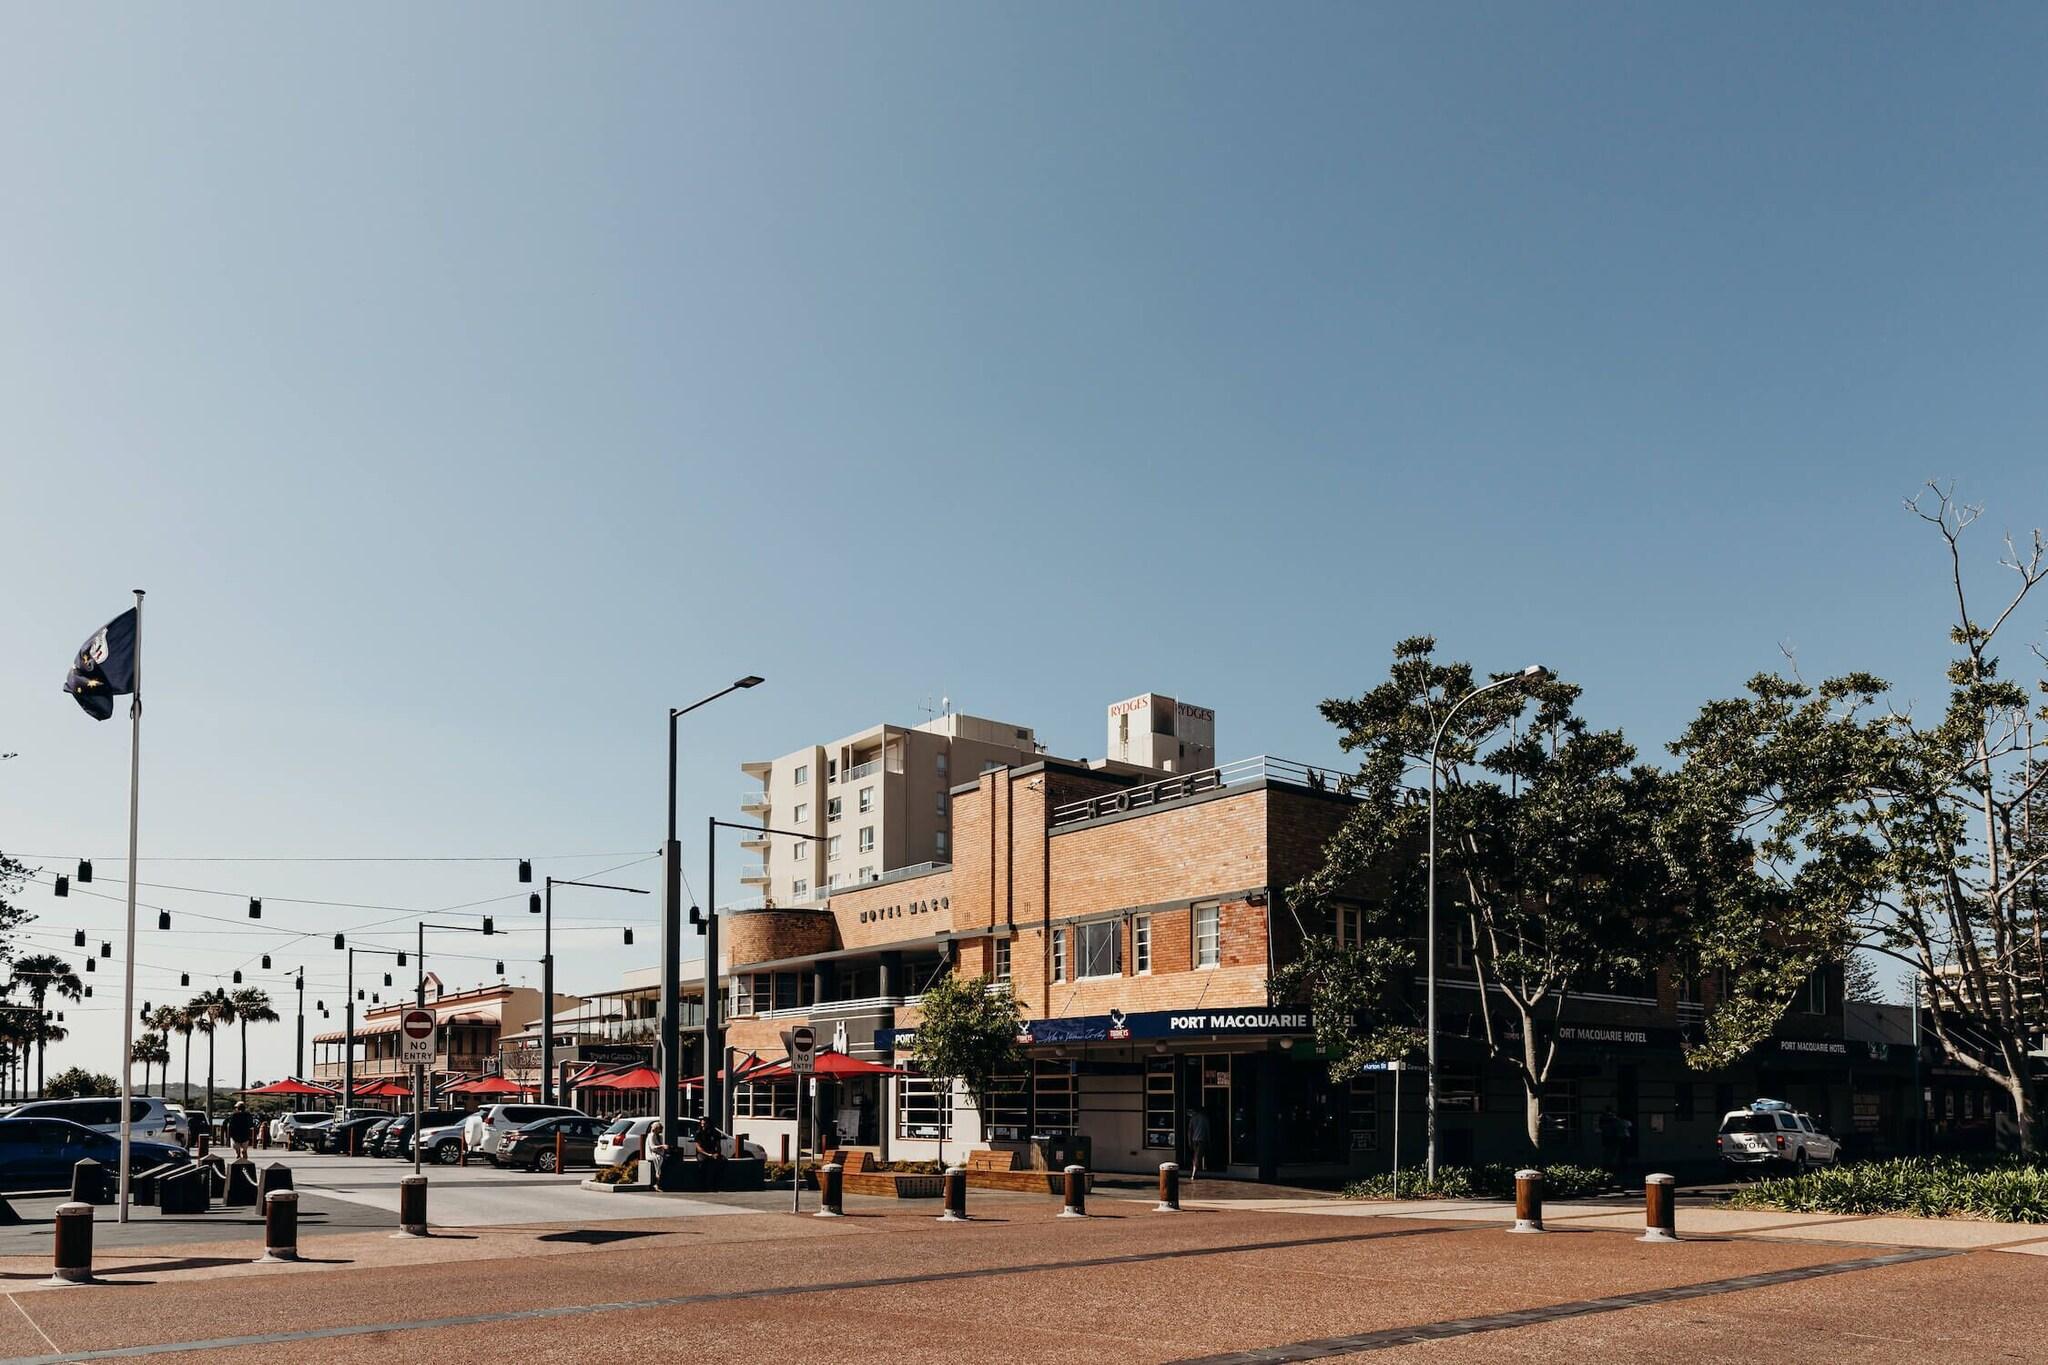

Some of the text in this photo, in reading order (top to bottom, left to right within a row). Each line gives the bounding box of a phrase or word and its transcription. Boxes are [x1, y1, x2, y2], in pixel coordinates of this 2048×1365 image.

[1111, 695, 1149, 718] RYDGES
[860, 896, 949, 924] HOTEL MACQ
[1170, 1017, 1206, 1029] PORT
[1210, 1015, 1307, 1028] MACQUARIE
[1559, 1027, 1648, 1043] ORT MACQUARIE HOTEL
[410, 1041, 427, 1050] NO
[1780, 1041, 1796, 1051] PORT
[1829, 1044, 1847, 1054] HOTEL
[404, 1052, 433, 1060] ENTRY
[798, 1054, 809, 1062] NO
